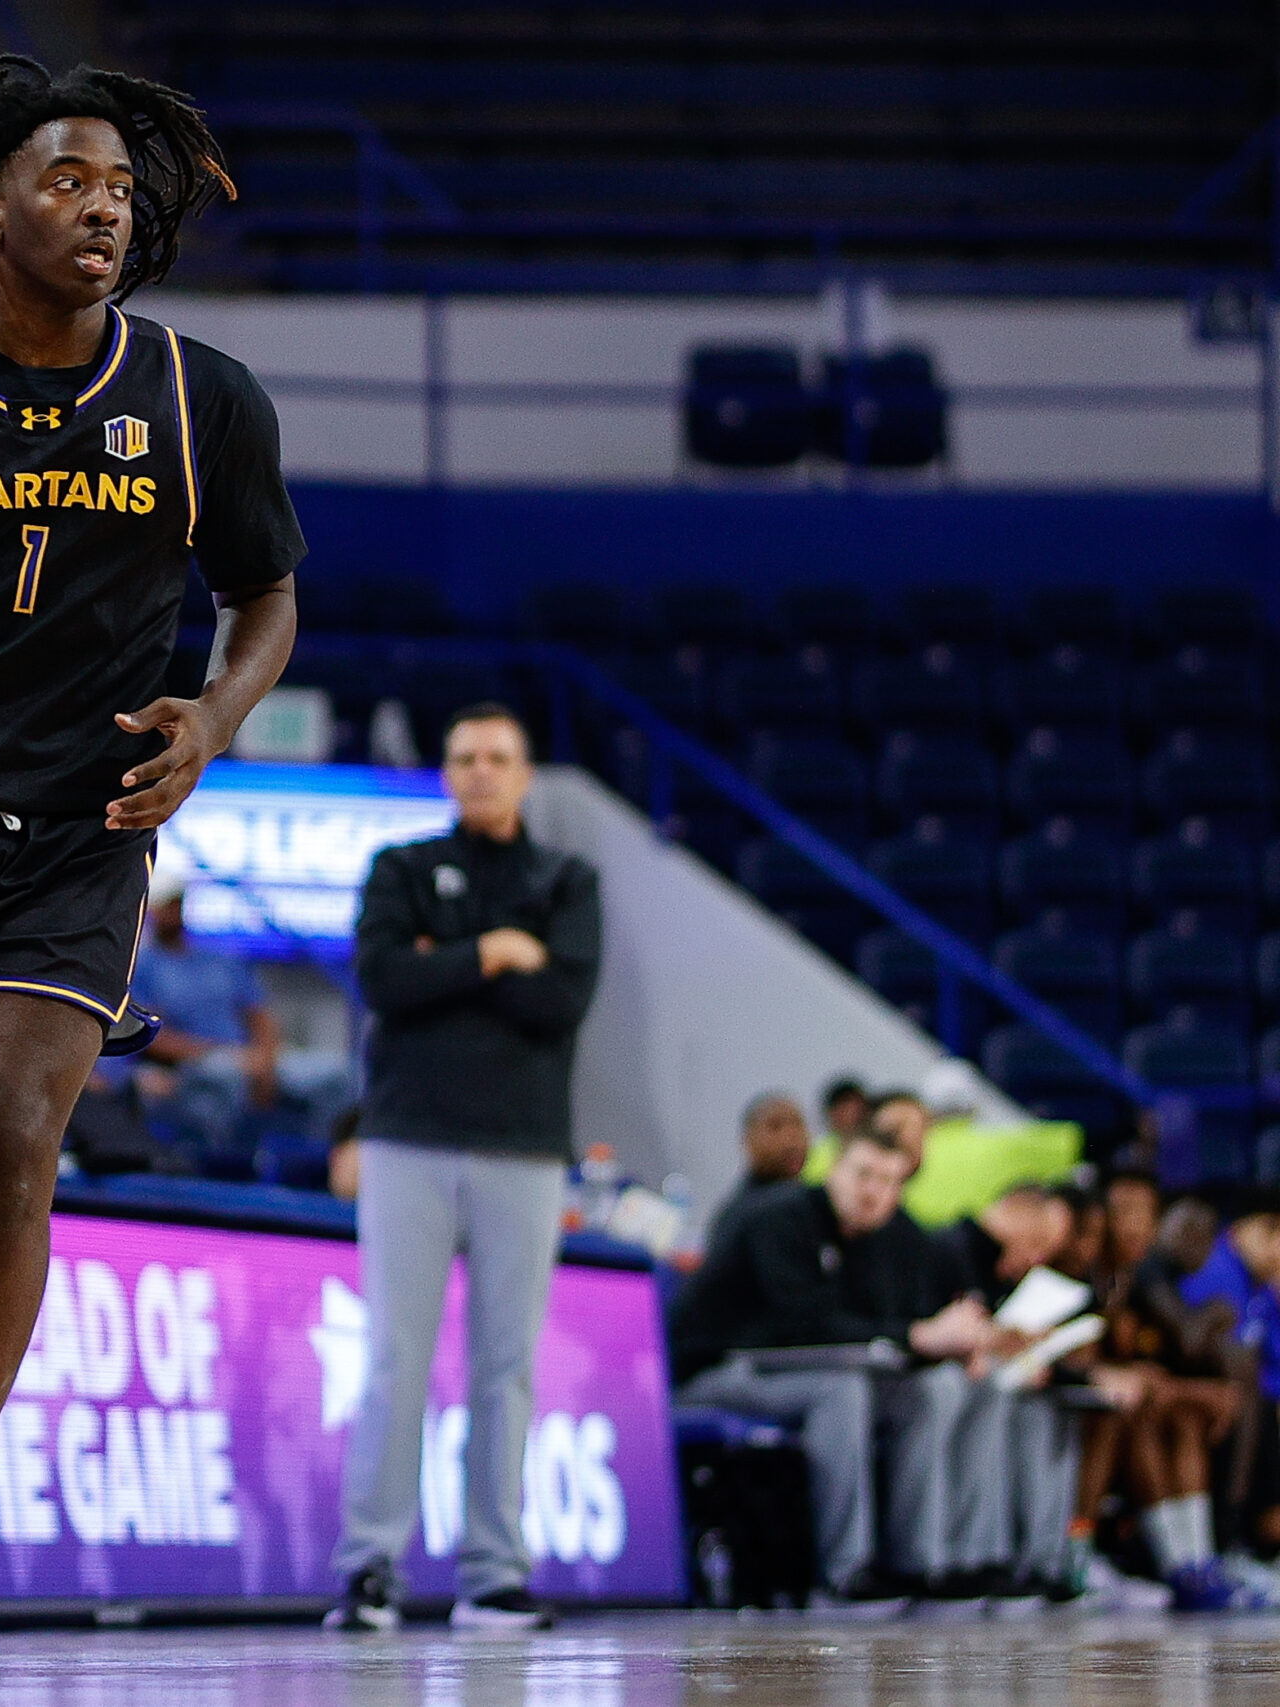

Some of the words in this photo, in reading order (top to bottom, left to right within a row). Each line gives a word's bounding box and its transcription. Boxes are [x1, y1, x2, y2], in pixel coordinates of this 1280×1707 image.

[13, 524, 50, 614] 1
[135, 1261, 220, 1406] OF
[57, 1400, 240, 1547] GAME
